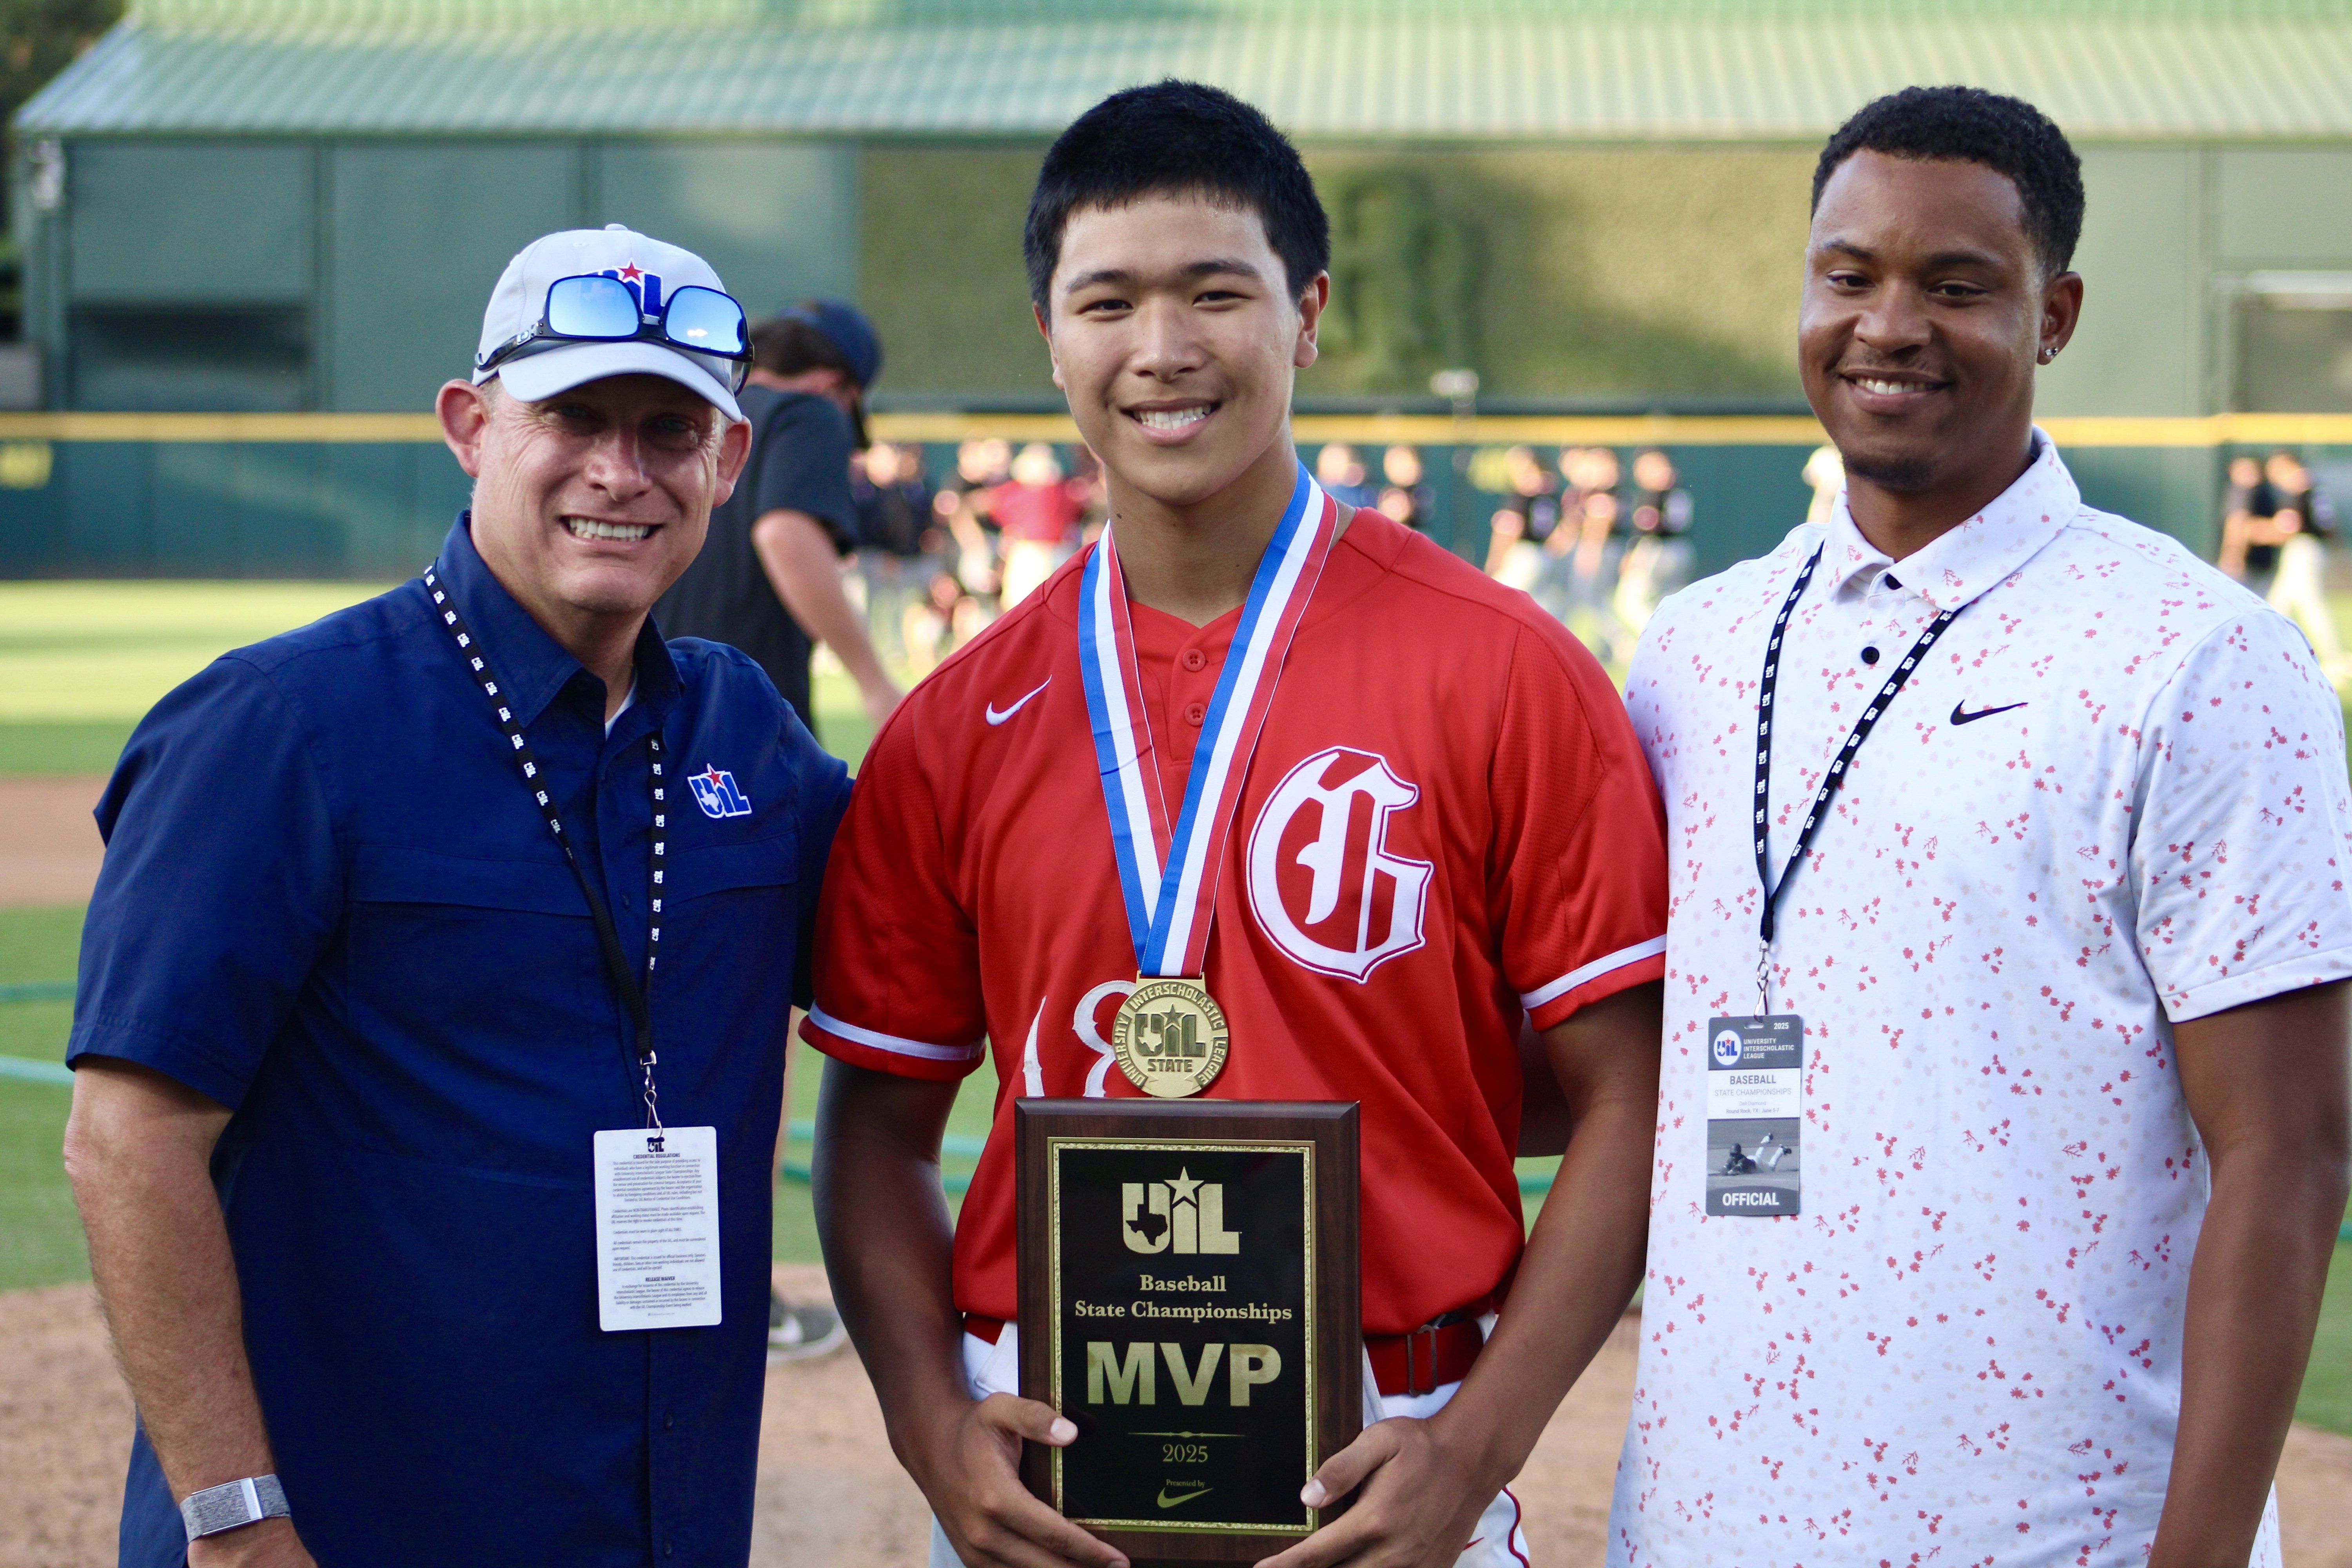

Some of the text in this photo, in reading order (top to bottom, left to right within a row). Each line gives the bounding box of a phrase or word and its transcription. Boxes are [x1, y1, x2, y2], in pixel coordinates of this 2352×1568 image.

[687, 763, 752, 818] UIL
[1247, 746, 1433, 984] G
[1114, 984, 1226, 1087] UNIVERSITY INTERSCHOLASTIC LEAGUE
[1135, 1003, 1205, 1057] UIL
[1717, 1038, 1737, 1056] UIL
[1147, 1059, 1193, 1072] STATE
[1730, 1075, 1776, 1085] BASEBALL
[1722, 1192, 1780, 1206] OFFICIAL
[1122, 1167, 1242, 1254] UIL
[1140, 1275, 1226, 1292] Baseball
[1076, 1300, 1292, 1324] State Championships
[1087, 1342, 1281, 1406] MVP
[1163, 1444, 1208, 1462] 2025
[1198, 1480, 1205, 1488] by
